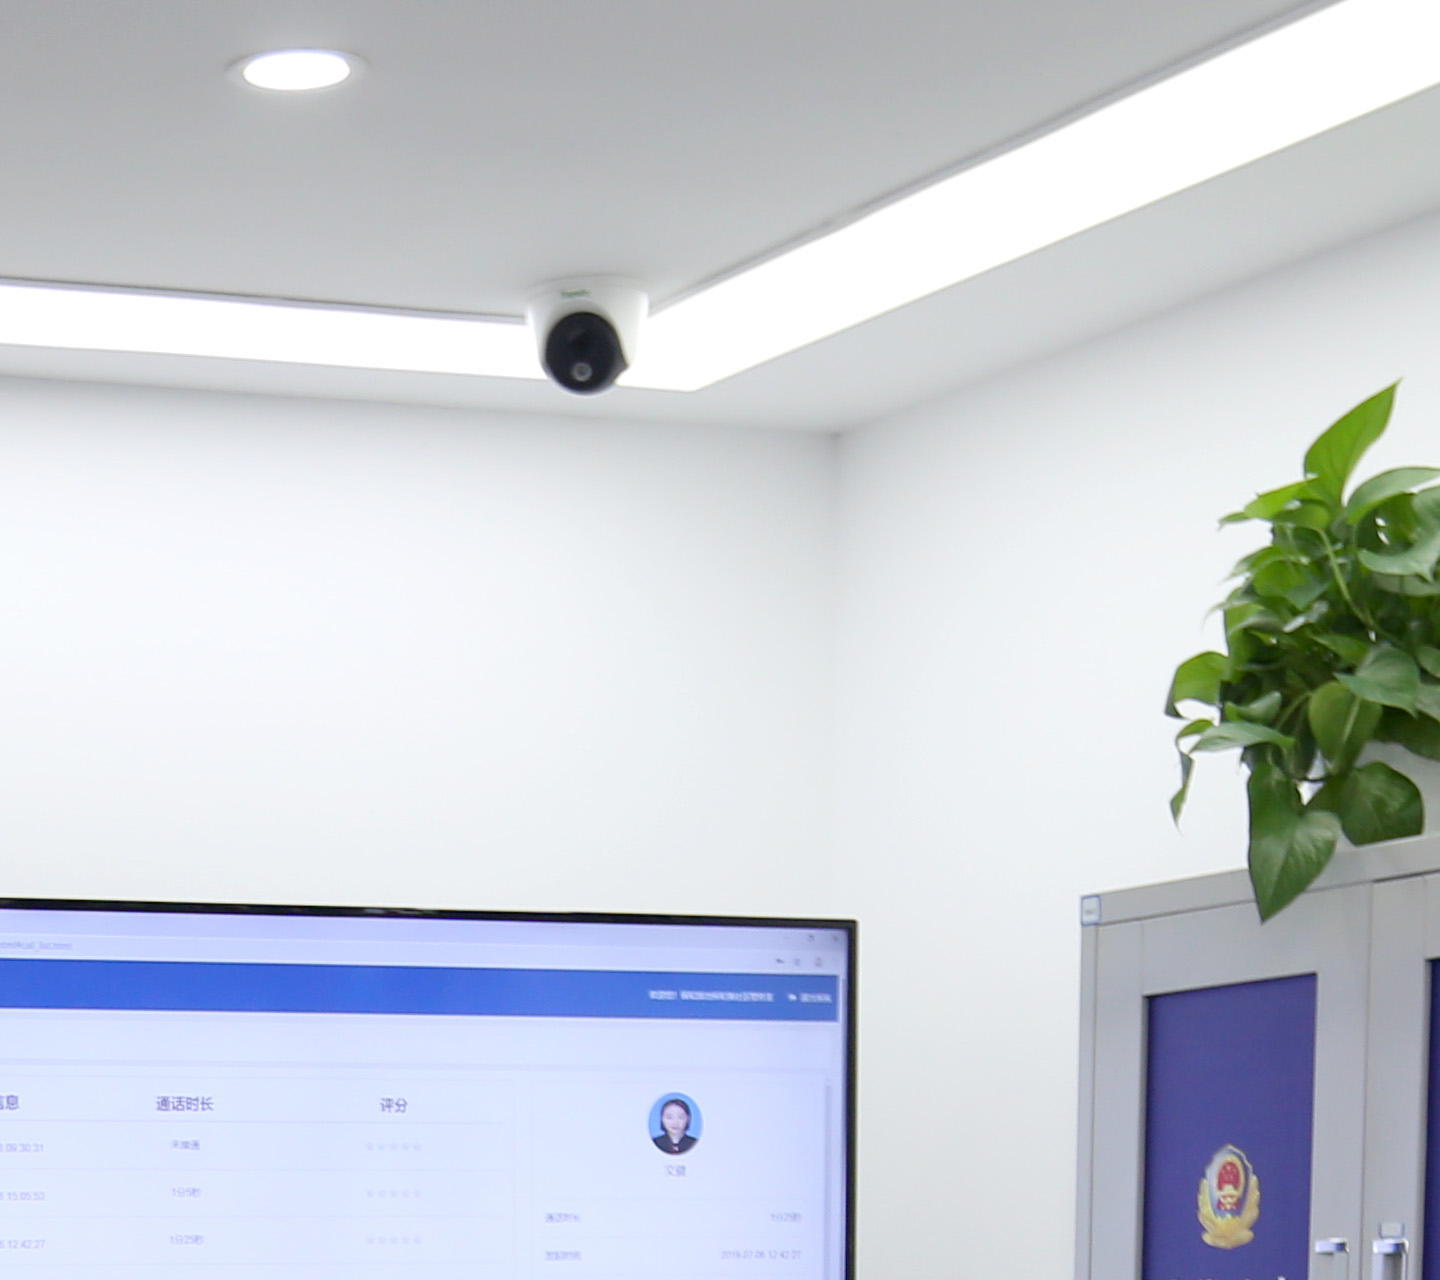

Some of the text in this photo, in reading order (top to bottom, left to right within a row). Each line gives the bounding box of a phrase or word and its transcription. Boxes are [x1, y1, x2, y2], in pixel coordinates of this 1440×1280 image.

[156, 1096, 214, 1113] 通话时长
[380, 1098, 408, 1114] 评分
